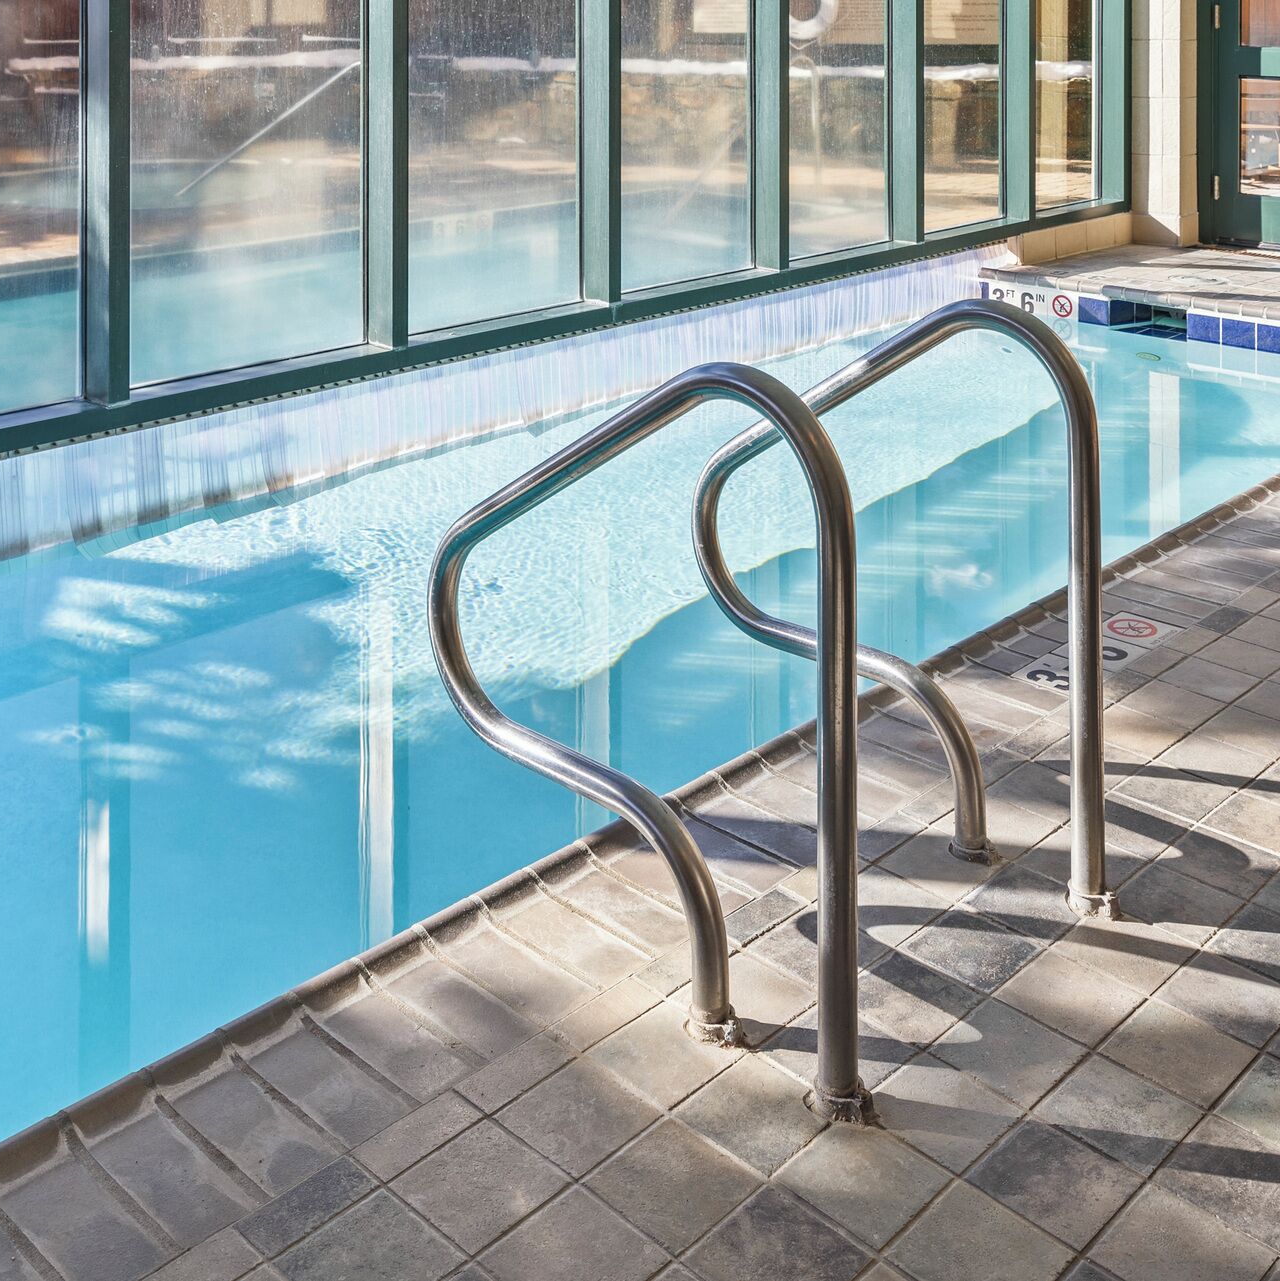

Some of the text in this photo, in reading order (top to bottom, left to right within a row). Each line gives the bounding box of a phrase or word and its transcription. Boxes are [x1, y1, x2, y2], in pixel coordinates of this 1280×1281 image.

[1006, 289, 1015, 298] FT
[1021, 292, 1034, 314] 6
[1035, 293, 1045, 303] IN
